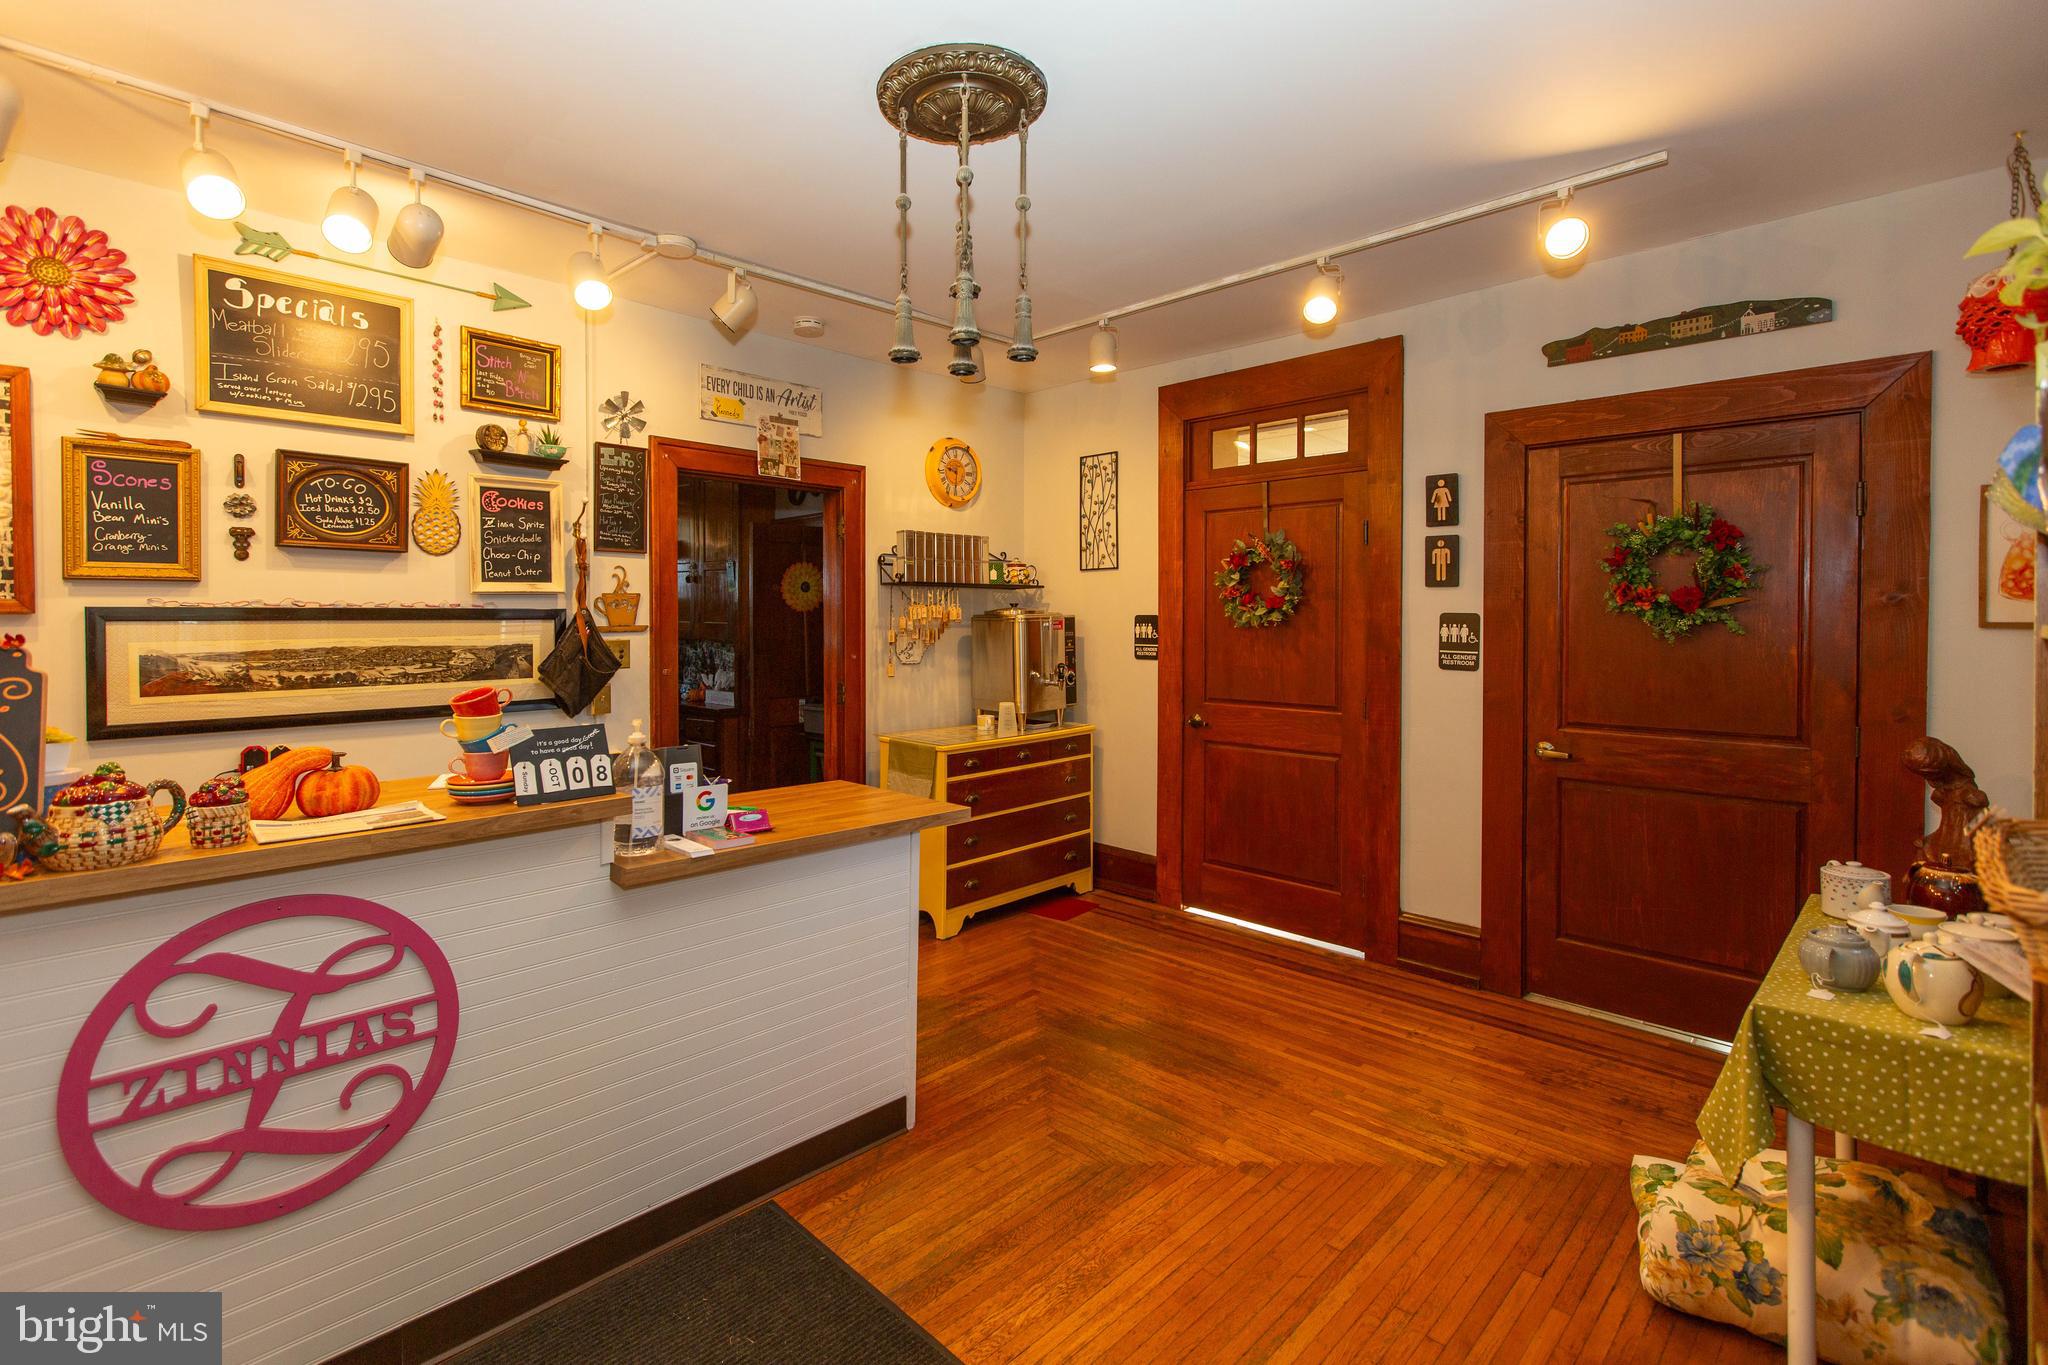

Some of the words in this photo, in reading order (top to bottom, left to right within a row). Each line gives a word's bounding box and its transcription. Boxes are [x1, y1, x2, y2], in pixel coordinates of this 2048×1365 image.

[224, 277, 369, 329] Specials
[211, 307, 285, 337] Meatball
[253, 336, 311, 363] Slider
[476, 344, 512, 369] Stitch
[211, 361, 259, 383] Island
[266, 372, 298, 386] Grain
[304, 375, 343, 394] Salad
[347, 382, 397, 413] $12.95
[244, 385, 261, 393] over
[706, 375, 731, 395] EVERY
[733, 381, 754, 399] CHILD
[756, 386, 763, 401] IS
[766, 388, 775, 403] AN
[775, 388, 817, 411] Artist
[90, 460, 172, 491] Scones
[310, 477, 367, 494] TO-GO
[90, 490, 146, 511] Vanilla
[299, 503, 321, 512] Iced
[324, 504, 349, 513] Drinks
[352, 506, 380, 515] $2.50
[305, 493, 322, 504] Hot
[324, 493, 354, 504] Drinks
[358, 496, 374, 507] $2
[482, 490, 544, 512] Cookies
[92, 510, 125, 523] Bean
[518, 517, 545, 530] Spritz
[483, 530, 542, 545] Snickerdoodle
[92, 542, 135, 554] Orange
[484, 560, 511, 579] Peanut
[514, 565, 543, 576] Butter
[554, 738, 569, 746] good
[570, 736, 582, 744] day
[549, 768, 560, 787] OCT
[572, 767, 584, 783] 0
[596, 765, 608, 781] 8
[699, 819, 720, 828] Google
[122, 1007, 417, 1118] ZINNIAS
